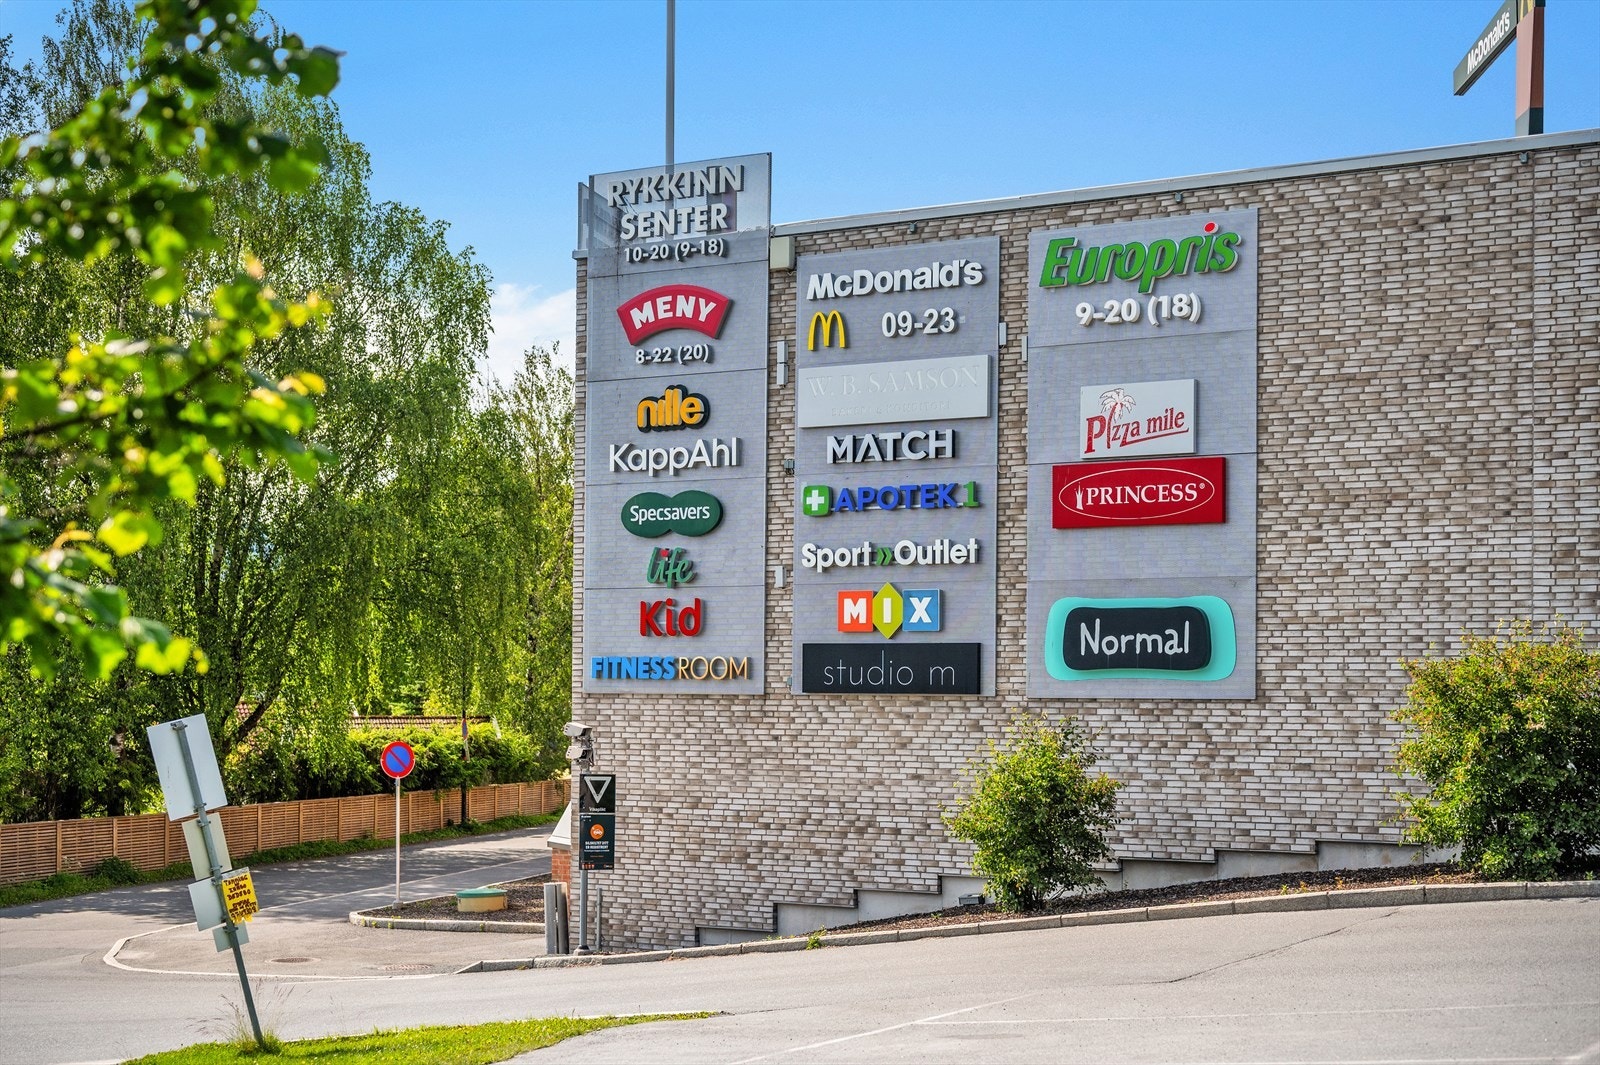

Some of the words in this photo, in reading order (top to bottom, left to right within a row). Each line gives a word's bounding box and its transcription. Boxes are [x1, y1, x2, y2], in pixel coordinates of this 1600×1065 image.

[1467, 11, 1510, 75] McDonald's
[607, 164, 744, 208] RYKKINN
[620, 203, 728, 240] SENTER
[624, 244, 669, 262] 10-20
[674, 238, 724, 261] (9-18)
[1039, 221, 1241, 294] Europris
[806, 259, 984, 300] McDonald's
[629, 295, 717, 330] MENY
[881, 307, 956, 337] 09-23
[1076, 298, 1140, 327] 9-20
[1147, 292, 1201, 327] (18)
[635, 347, 672, 364] 8-22
[677, 344, 710, 364] (20)
[806, 376, 833, 398] W.
[842, 374, 861, 395] B.
[868, 364, 981, 393] SAMSON
[637, 387, 705, 429] nille
[1146, 407, 1185, 434] mile
[609, 437, 741, 477] KappAhl
[827, 429, 954, 464] MATCH
[629, 504, 710, 526] Specsavers
[646, 546, 696, 589] life
[801, 541, 872, 573] Sport
[894, 538, 978, 565] Outlet
[639, 598, 702, 637] Kid
[843, 597, 932, 624] MIX
[1080, 618, 1190, 656] Normal
[823, 650, 914, 686] studio
[929, 666, 955, 686] m
